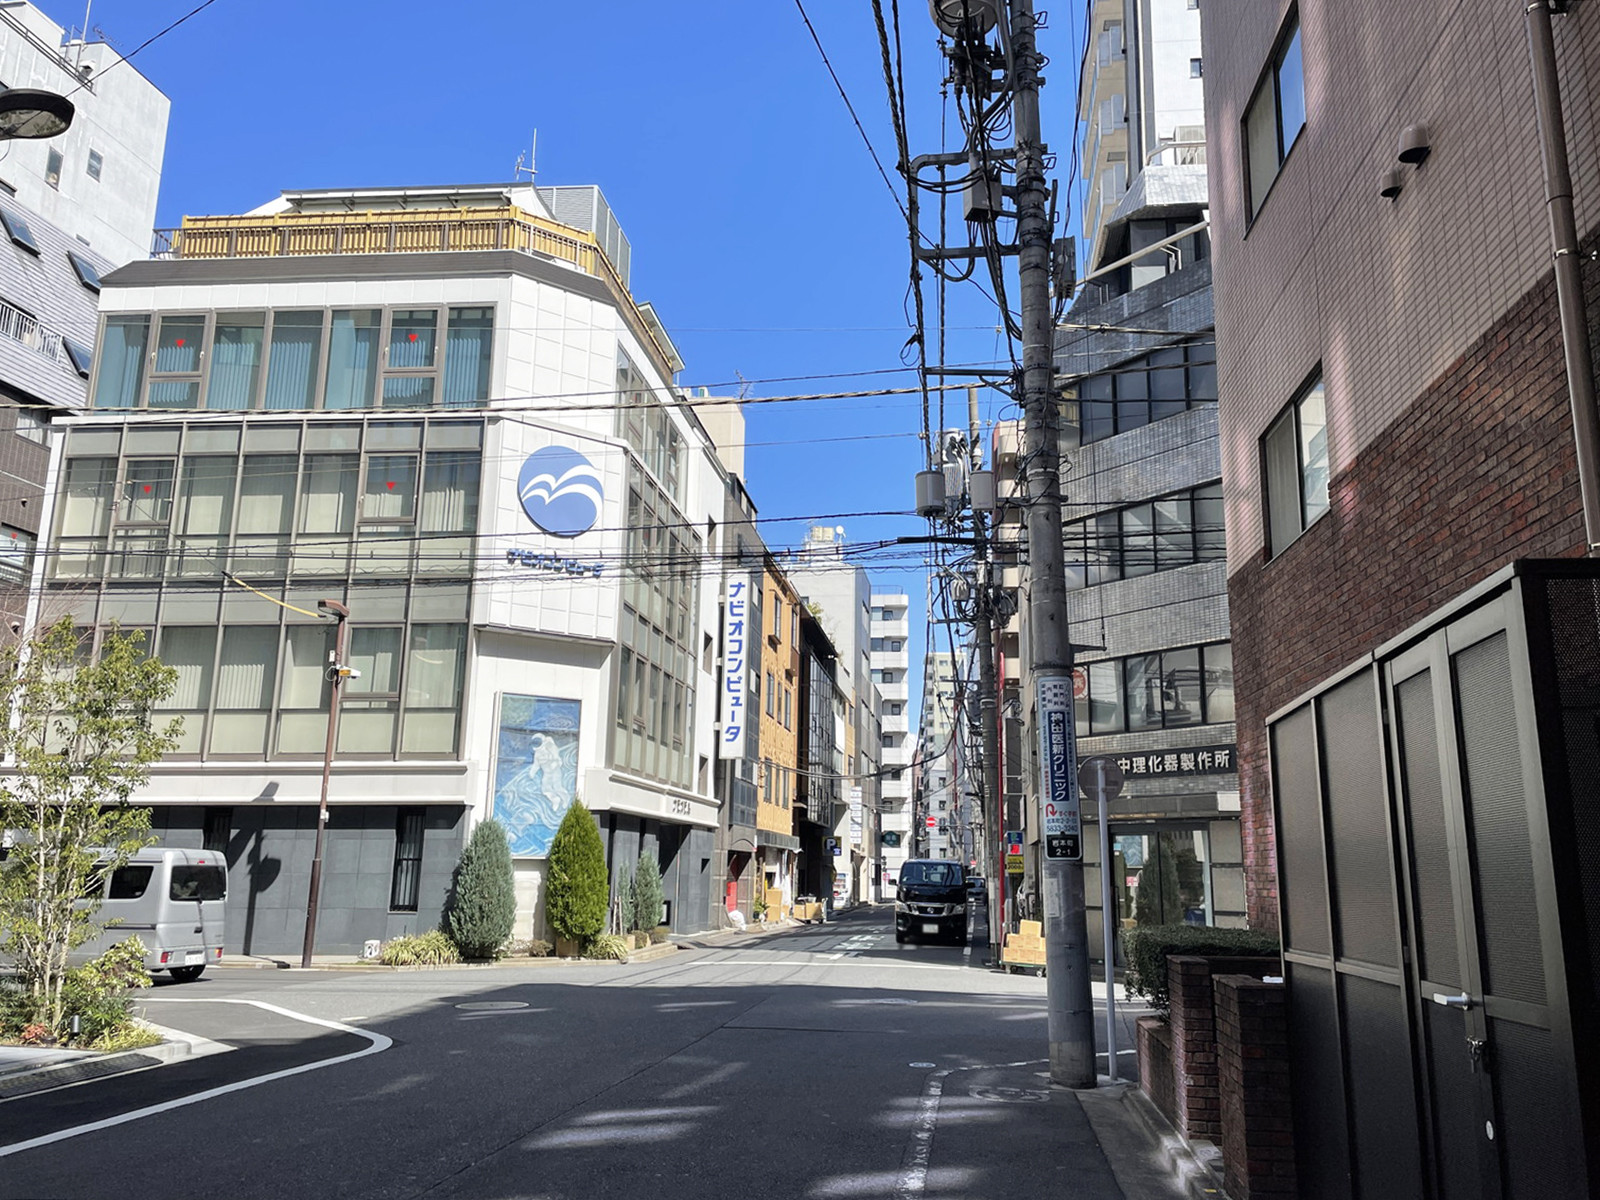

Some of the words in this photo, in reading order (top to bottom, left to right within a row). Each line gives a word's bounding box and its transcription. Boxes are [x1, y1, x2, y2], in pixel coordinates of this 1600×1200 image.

[725, 581, 746, 742] ナビオコンピュータ
[1051, 712, 1067, 800] 神田医新クリニック
[1113, 750, 1230, 774] 中理化器製作所
[827, 838, 836, 850] P
